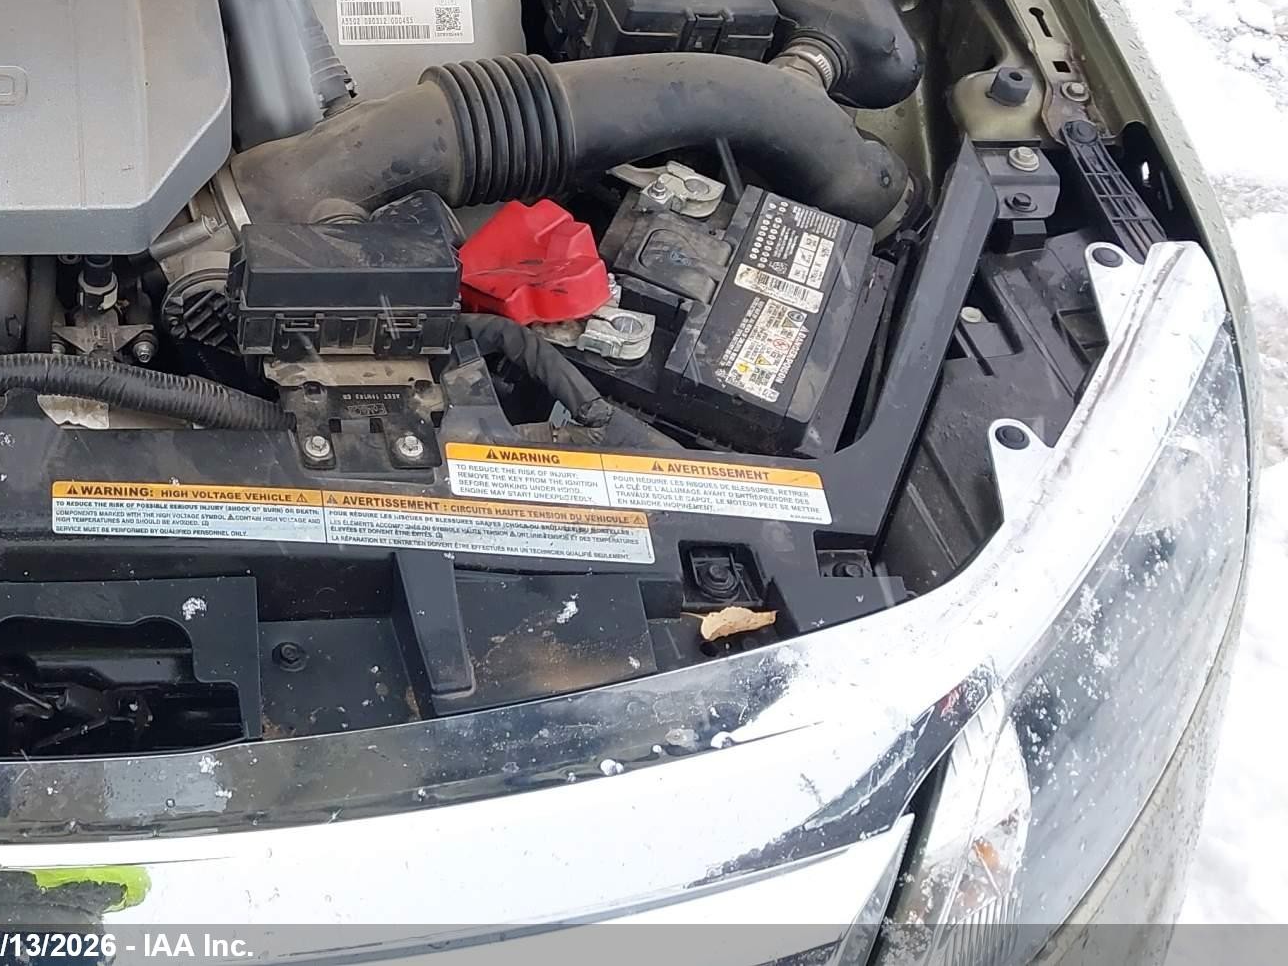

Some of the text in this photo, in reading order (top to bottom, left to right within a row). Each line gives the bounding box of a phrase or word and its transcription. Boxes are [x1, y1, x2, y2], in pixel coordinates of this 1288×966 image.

[500, 451, 560, 464] WARNING
[458, 472, 489, 480] REMOVE
[668, 464, 770, 480] AVERTISSEMENT
[458, 479, 488, 487] BEFORE
[492, 482, 528, 490] WORKING
[687, 481, 718, 489] RISQUES
[778, 489, 809, 497] RETIRER
[81, 486, 153, 497] WARNING:
[192, 491, 241, 500] VOLTAGE
[244, 493, 292, 502] VEHICLE
[490, 488, 505, 496] MAY
[508, 490, 531, 498] START
[343, 496, 440, 511] AVERTISSEMENT
[451, 505, 492, 514] CIRCUITS
[529, 510, 567, 520] TENSION
[791, 505, 820, 513] METTRE
